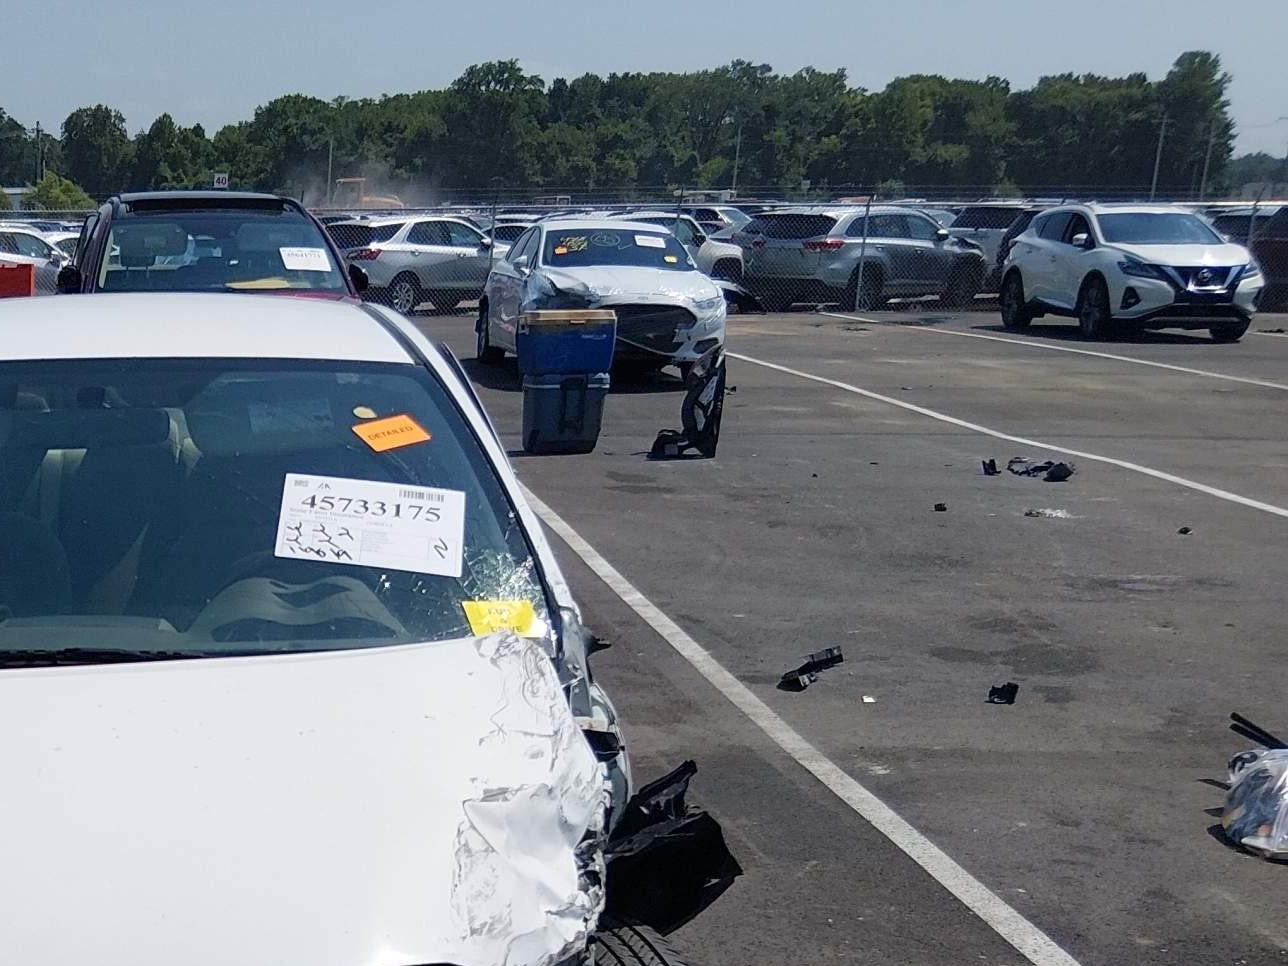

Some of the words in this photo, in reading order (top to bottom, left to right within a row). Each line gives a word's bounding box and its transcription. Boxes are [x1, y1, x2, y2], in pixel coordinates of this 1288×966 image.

[215, 176, 227, 185] 40
[368, 425, 414, 441] DETAILED
[301, 493, 441, 523] 45733175
